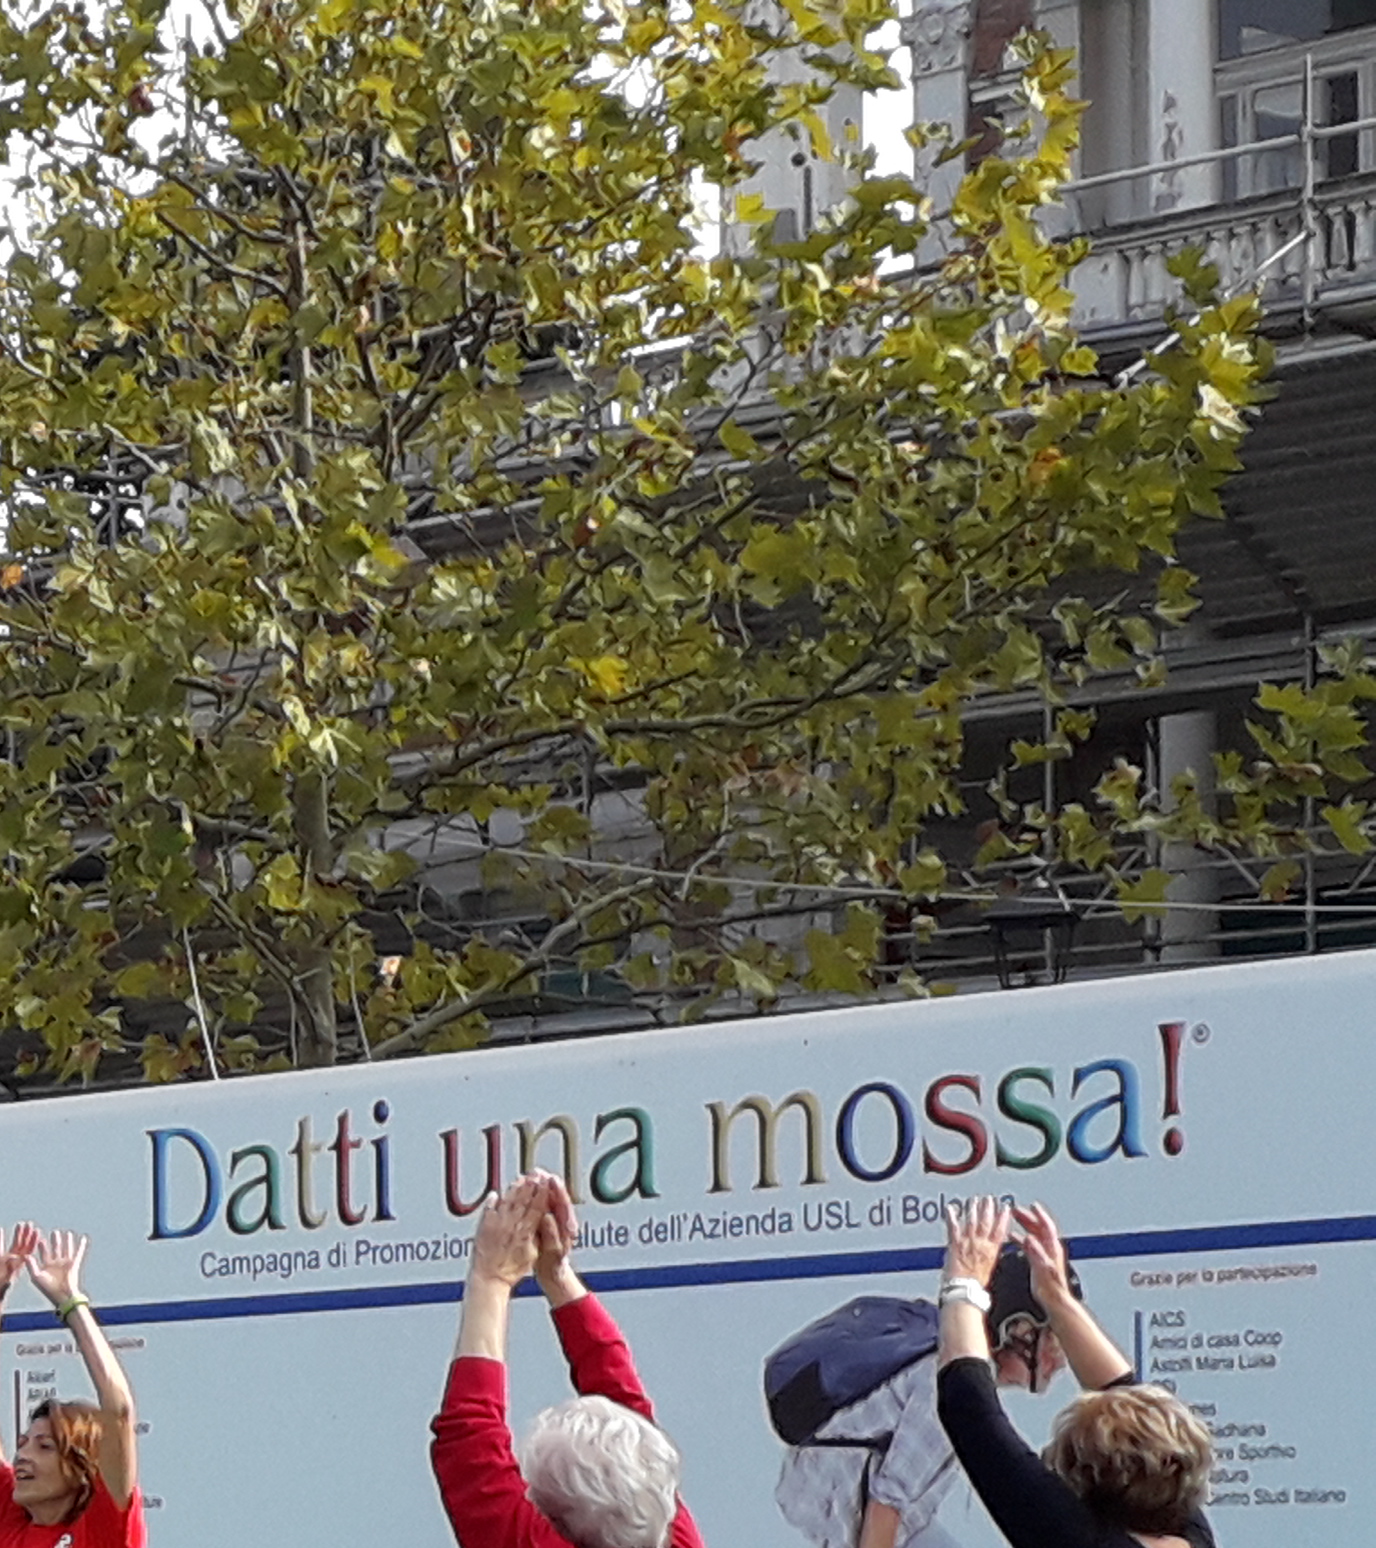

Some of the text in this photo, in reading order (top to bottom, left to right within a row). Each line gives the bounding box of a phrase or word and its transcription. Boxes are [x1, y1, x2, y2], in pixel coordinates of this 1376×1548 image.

[146, 1021, 1186, 1240] Datti una mossa!
[200, 1249, 321, 1281] Campagna
[327, 1241, 347, 1268] di
[355, 1233, 475, 1266] Promozion
[572, 1218, 629, 1249] alute
[639, 1207, 794, 1244] dell'Azienda
[803, 1200, 861, 1232] USL
[868, 1196, 892, 1226] di
